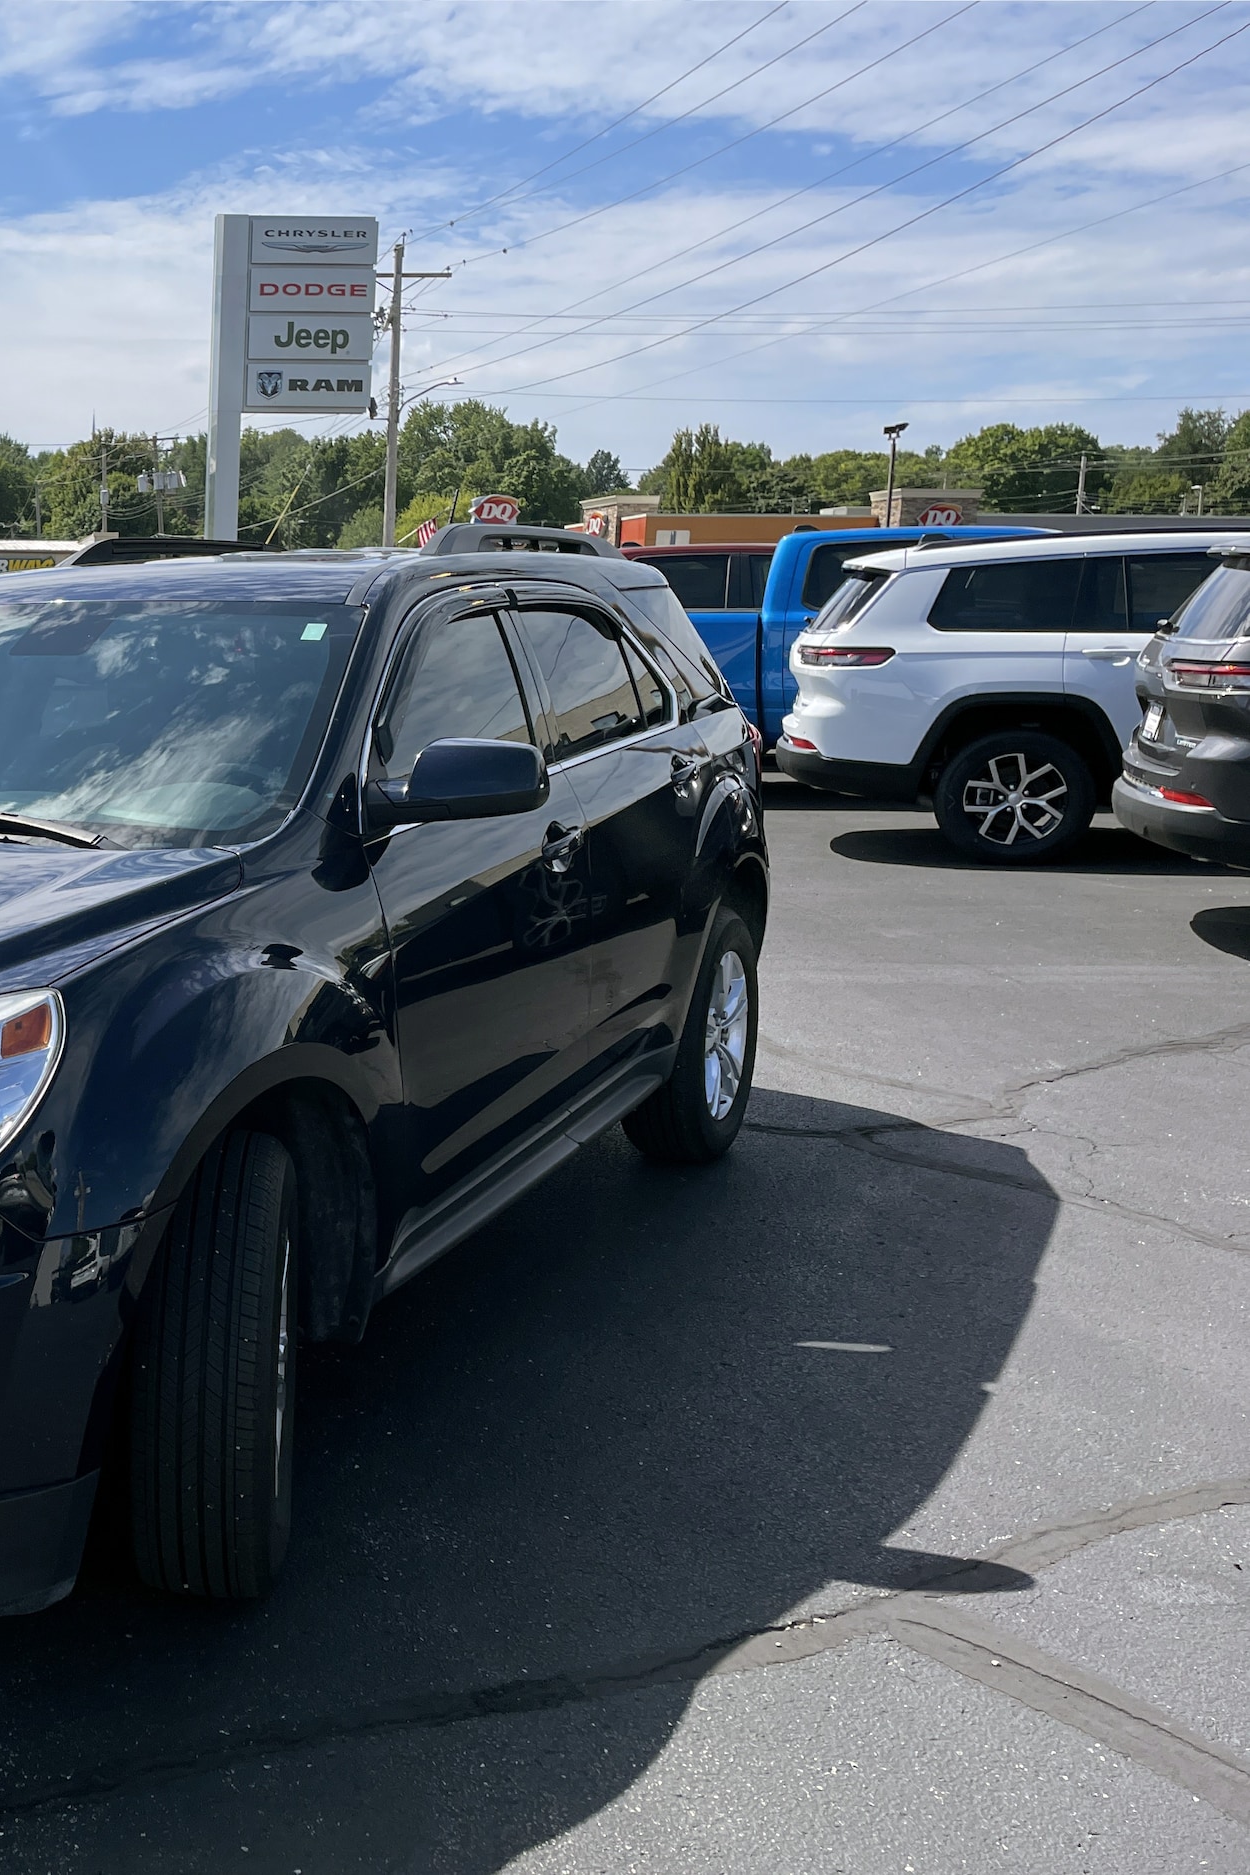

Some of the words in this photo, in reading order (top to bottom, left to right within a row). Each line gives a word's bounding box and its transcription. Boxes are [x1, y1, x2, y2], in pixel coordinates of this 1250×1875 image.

[264, 229, 367, 238] CHRYSLER
[259, 283, 367, 297] DODGE
[274, 321, 350, 354] Jeep
[288, 379, 363, 392] RAM
[481, 502, 512, 521] DQ
[926, 510, 957, 526] DQ
[588, 518, 601, 533] DQ
